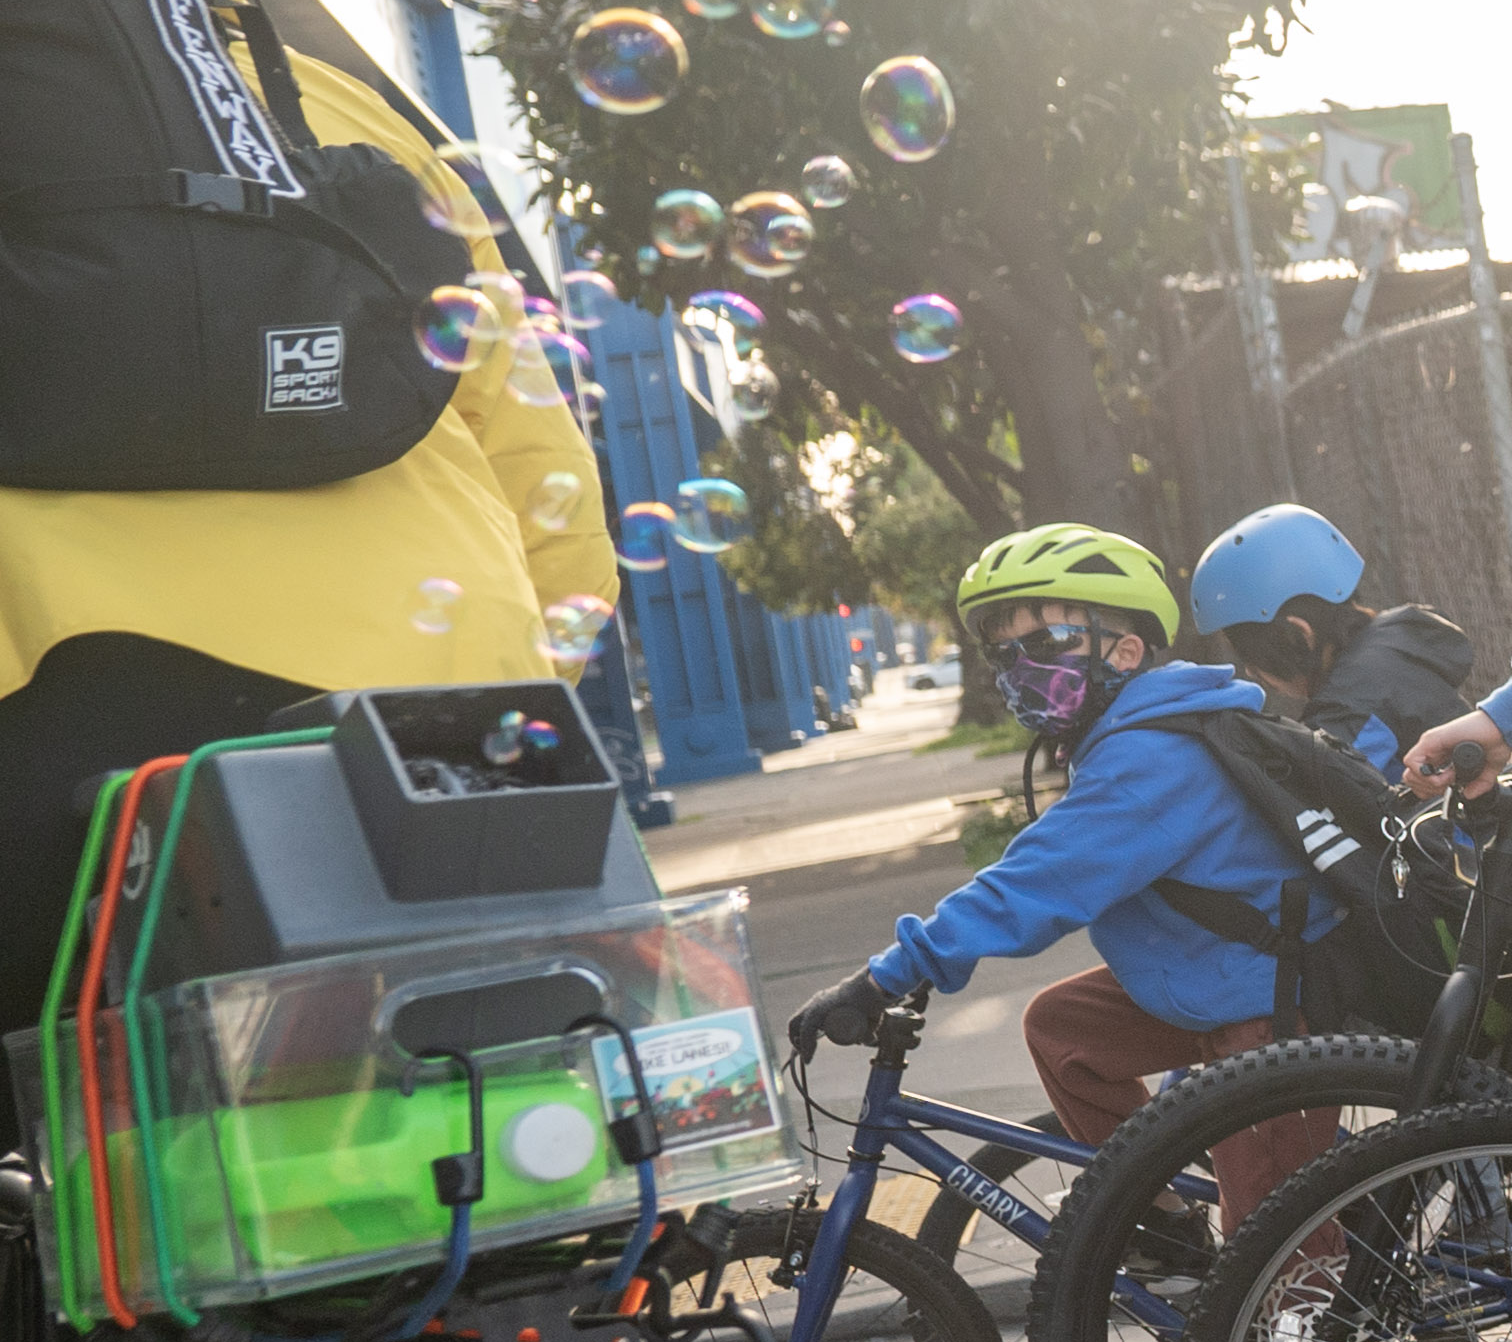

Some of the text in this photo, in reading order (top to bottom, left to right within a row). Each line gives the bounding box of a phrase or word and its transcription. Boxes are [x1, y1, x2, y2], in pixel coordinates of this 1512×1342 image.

[272, 335, 340, 372] K9
[272, 369, 340, 388] SPORT
[946, 1164, 1030, 1227] CLEARY
